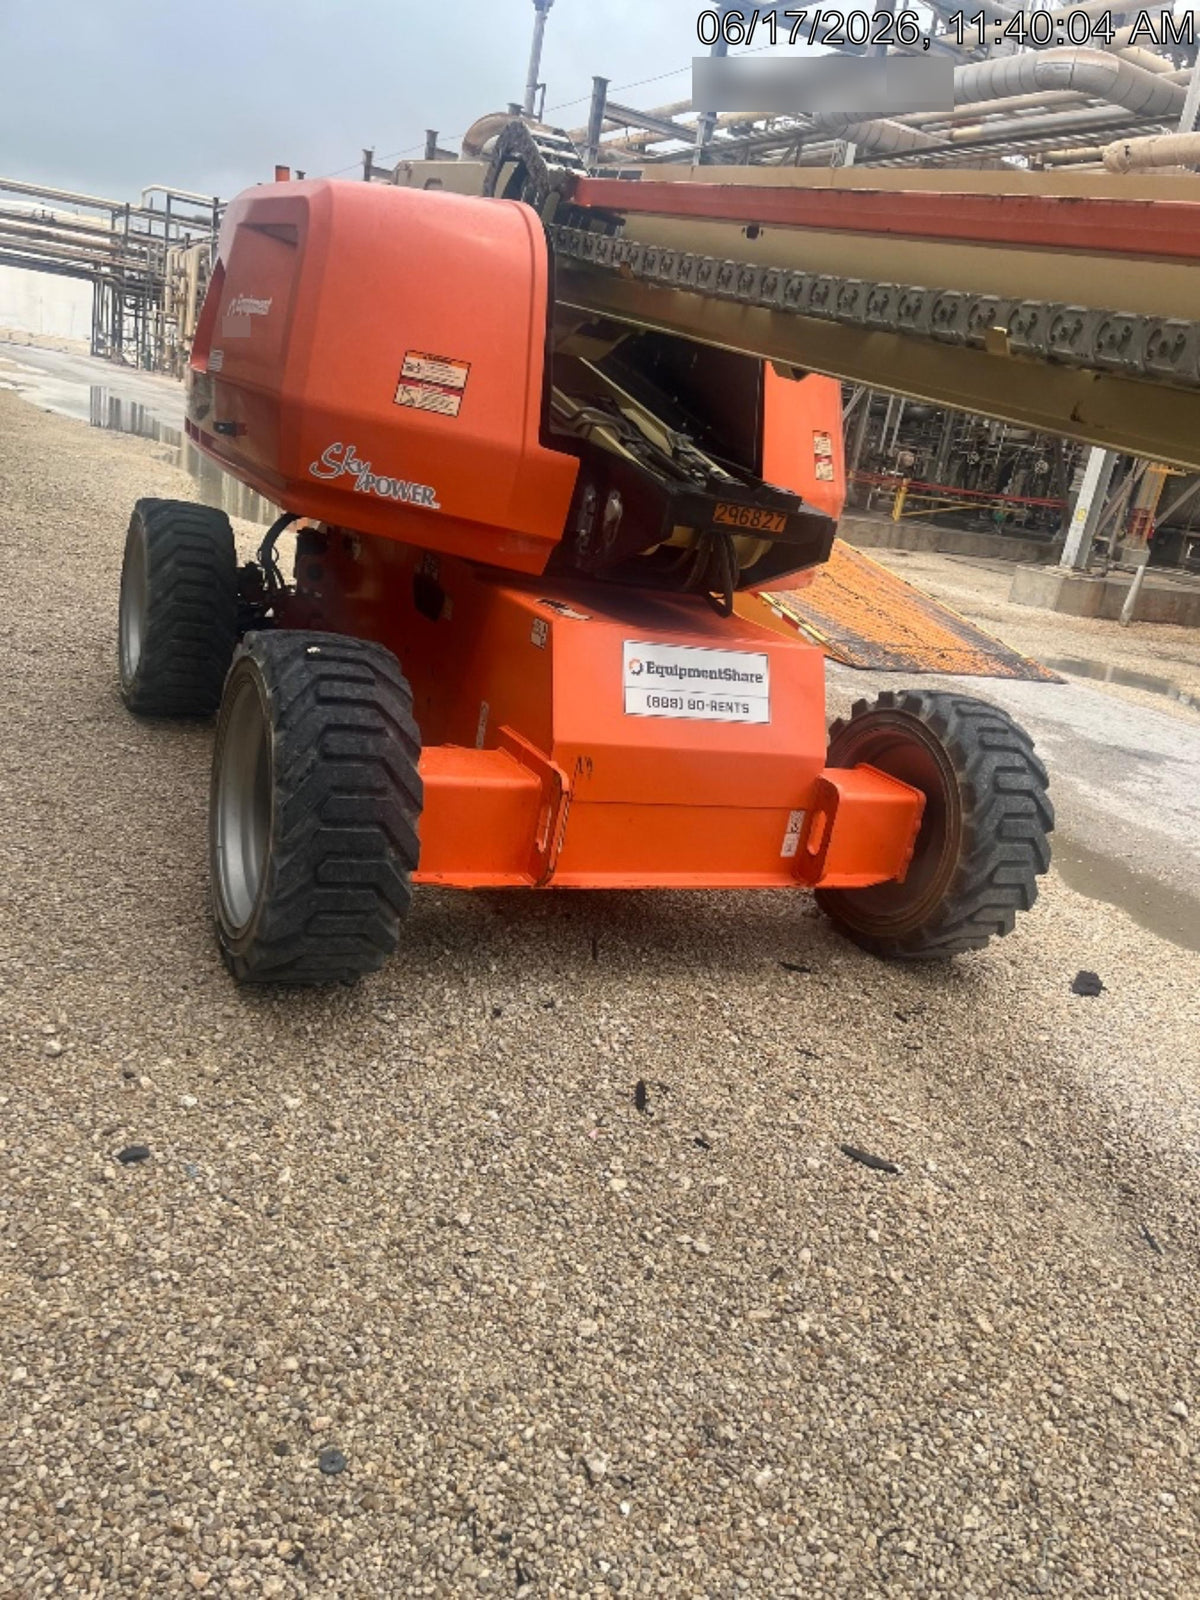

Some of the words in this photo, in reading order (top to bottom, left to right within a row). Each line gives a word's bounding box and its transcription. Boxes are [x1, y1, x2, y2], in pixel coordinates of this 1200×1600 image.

[309, 442, 371, 492] Sky
[362, 473, 437, 506] POWER
[714, 504, 785, 531] 296827
[646, 660, 764, 684] EquipmentShare
[646, 695, 684, 710] (888)
[687, 699, 750, 714] 80-RENTS
